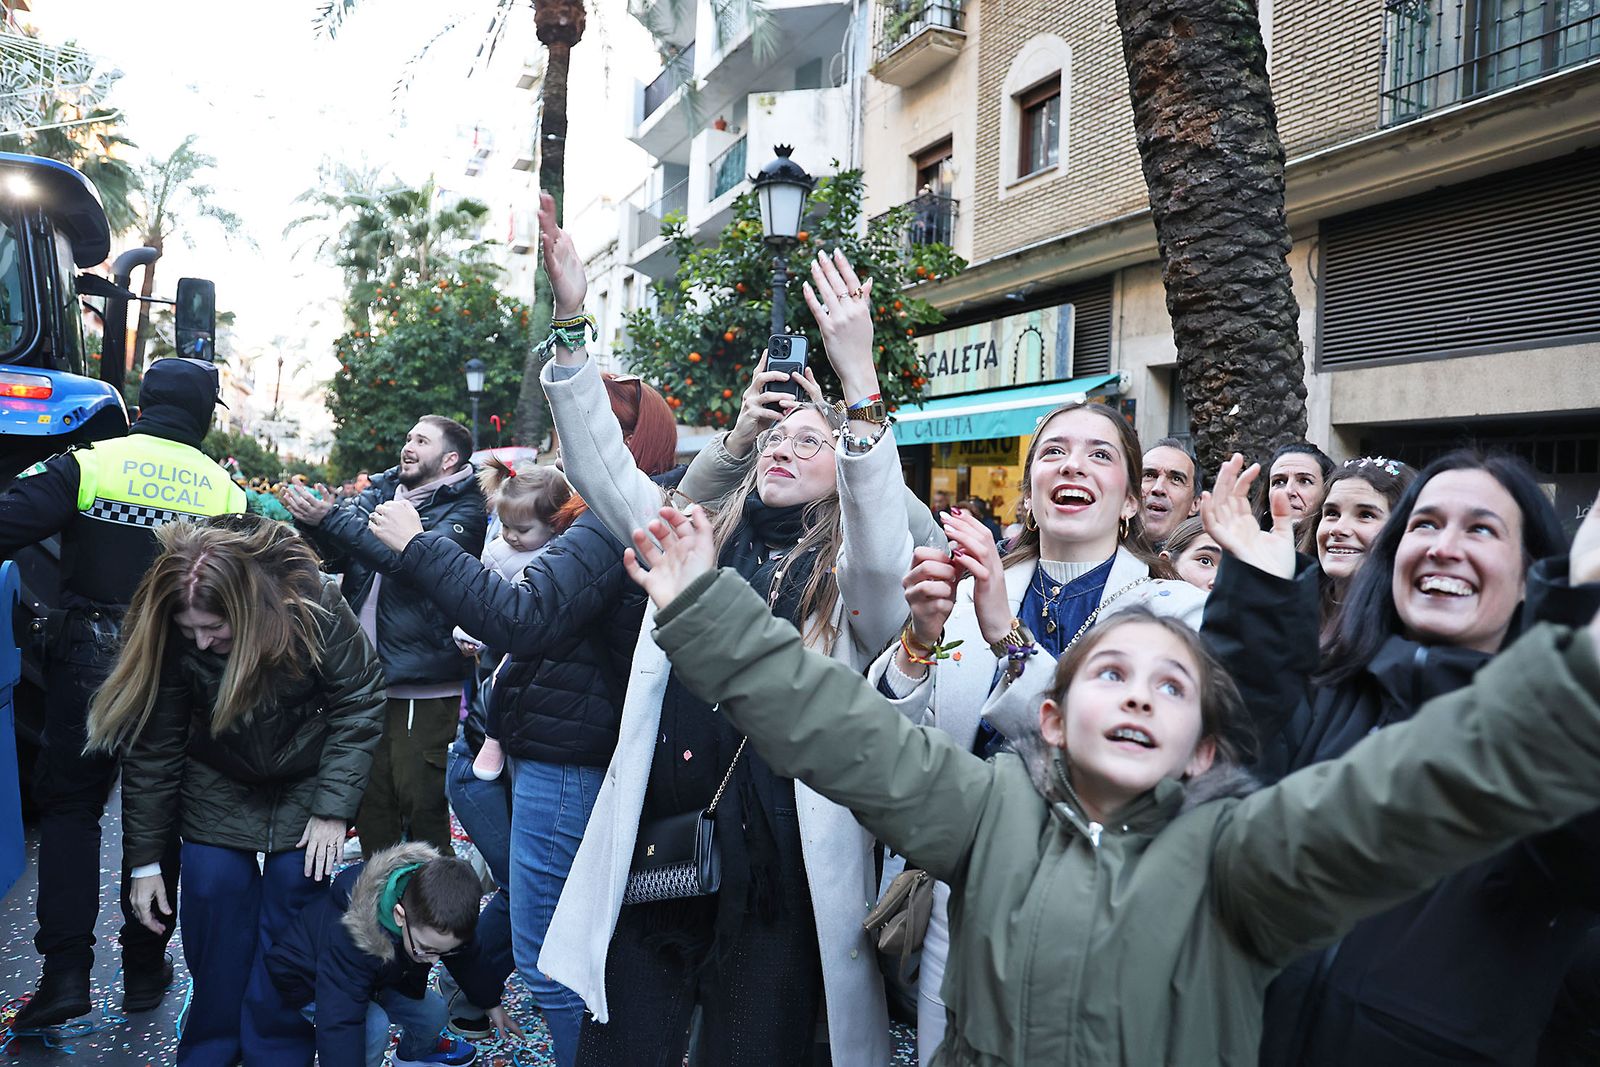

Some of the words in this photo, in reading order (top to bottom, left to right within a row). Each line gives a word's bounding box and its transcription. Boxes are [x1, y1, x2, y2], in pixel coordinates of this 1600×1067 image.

[924, 339, 998, 378] CALETA
[914, 417, 972, 438] CALETA
[123, 460, 212, 490] POLICIA
[128, 480, 205, 507] LOCAL
